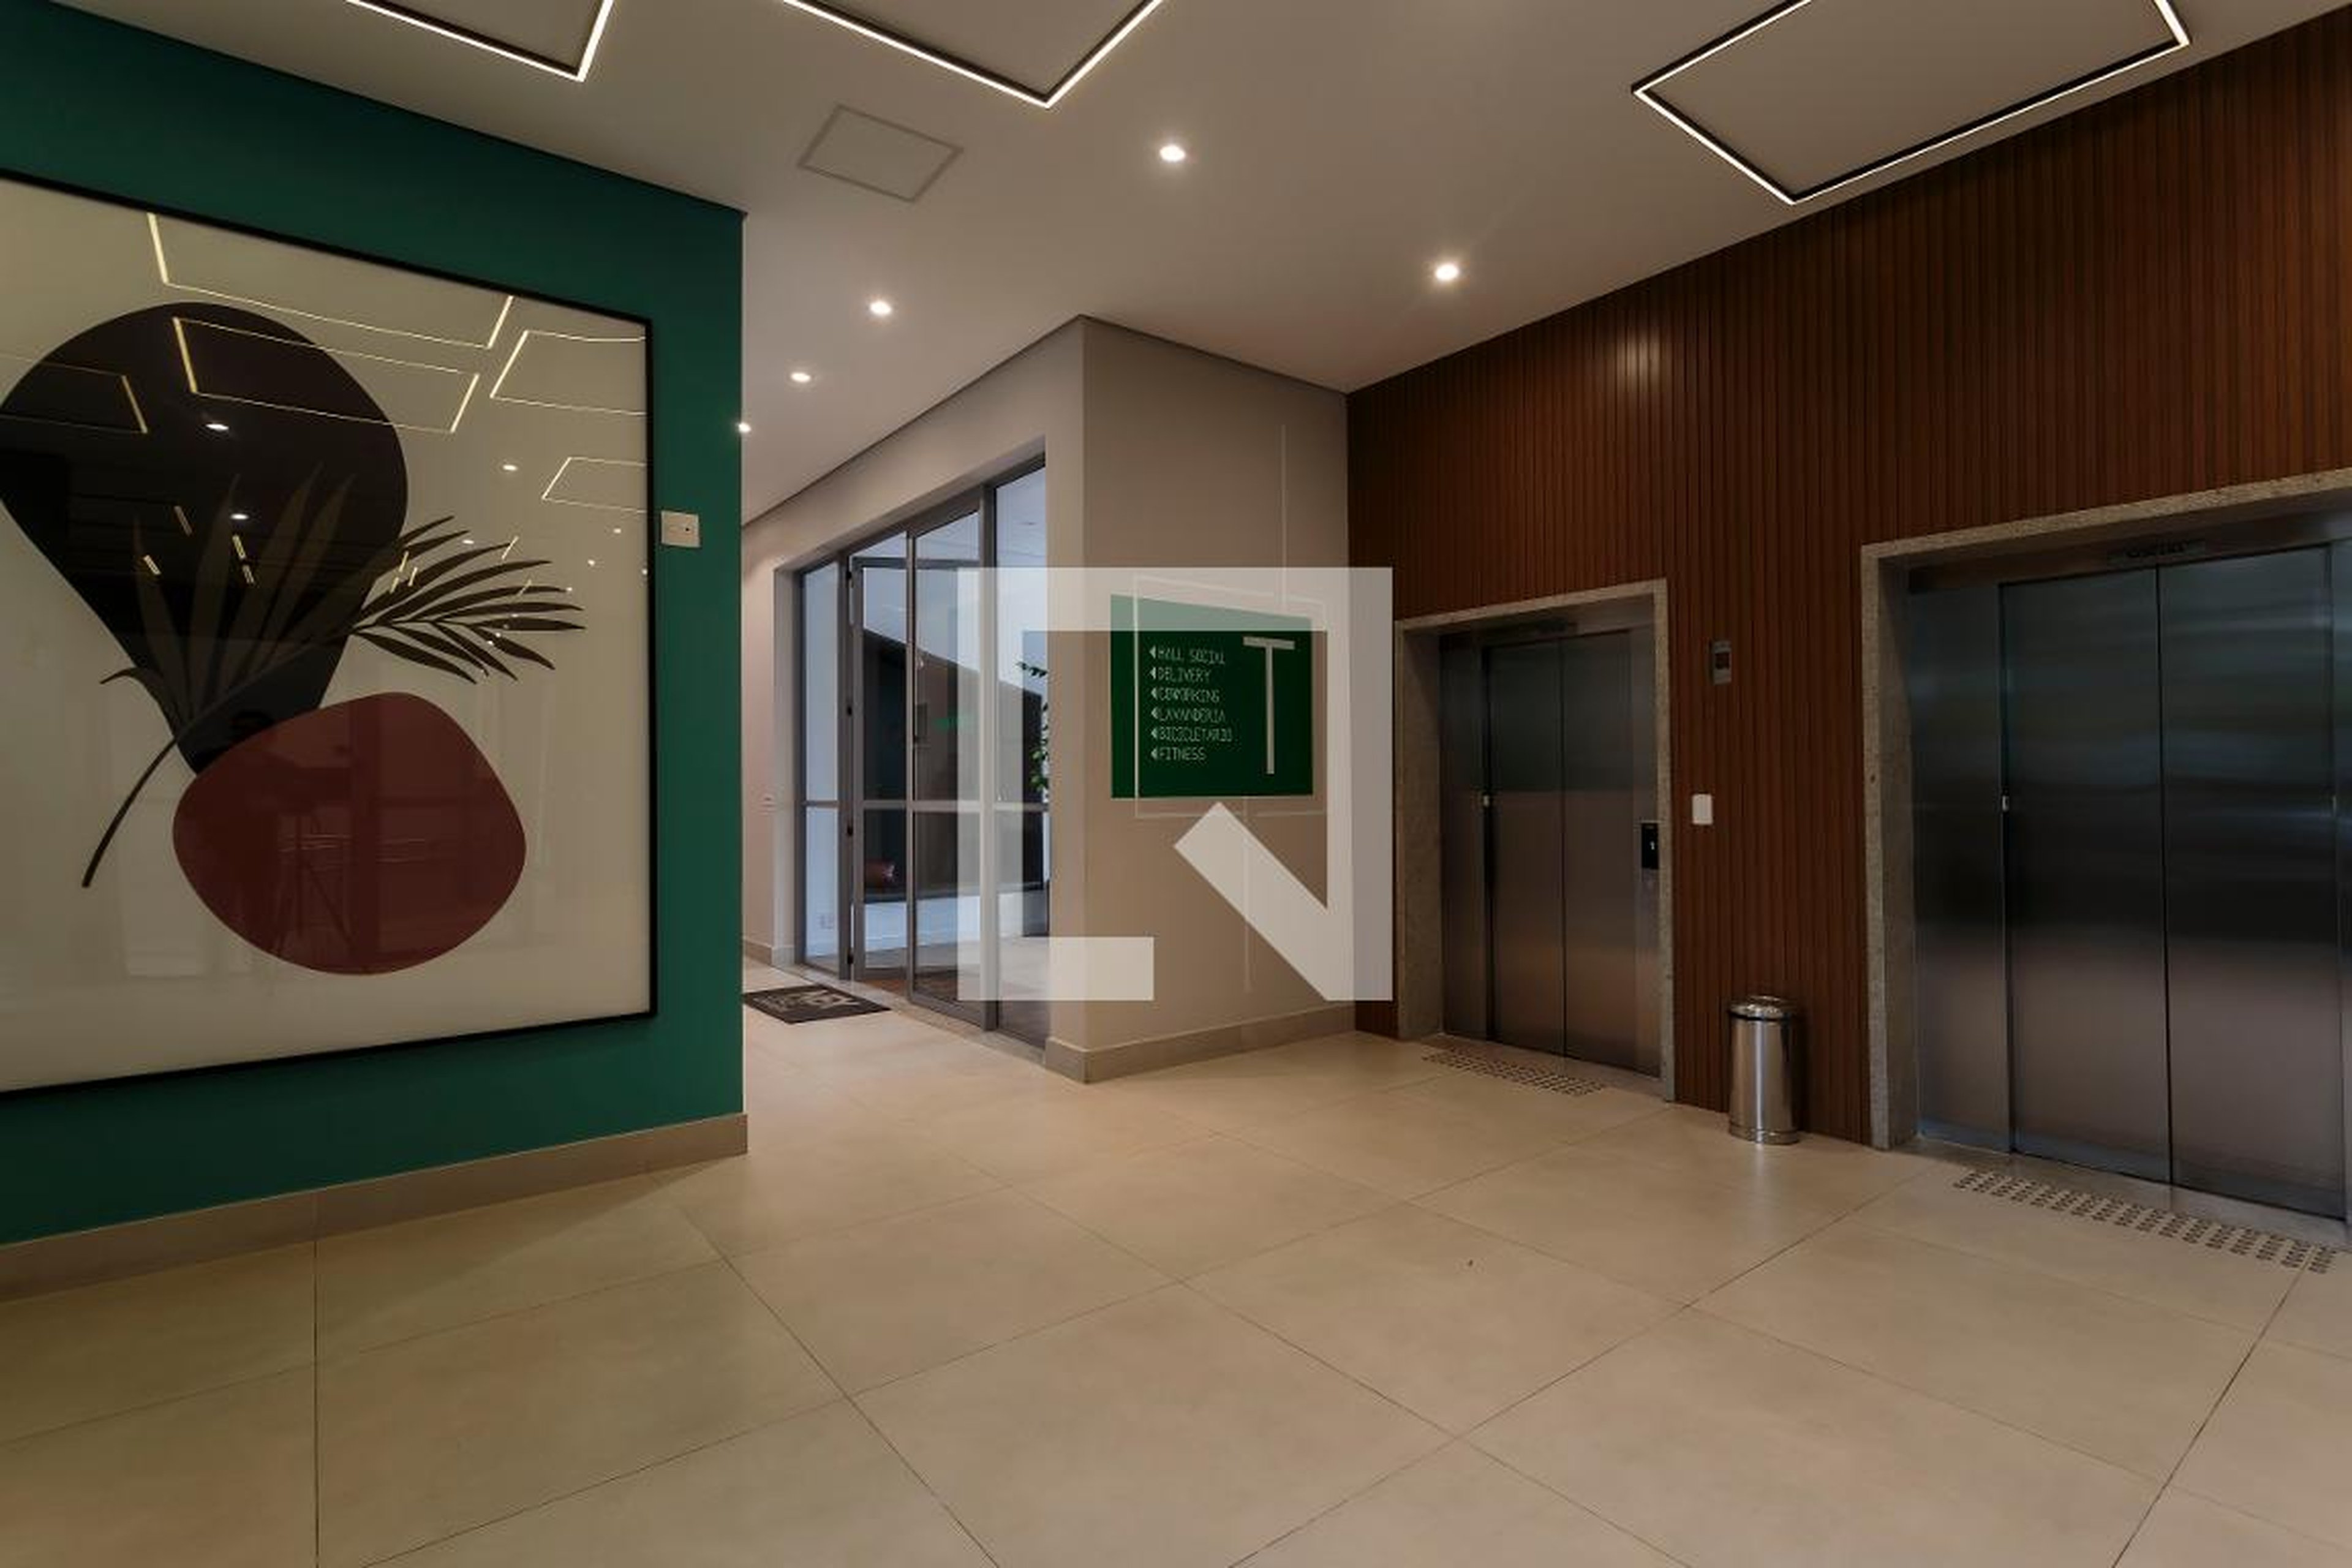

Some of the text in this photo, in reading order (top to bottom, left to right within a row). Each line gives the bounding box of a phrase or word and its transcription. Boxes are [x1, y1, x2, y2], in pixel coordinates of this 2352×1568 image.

[1158, 646, 1225, 665] HALL SOCIAL
[1158, 666, 1212, 683] DELIVERY
[1159, 687, 1220, 703] COWORKING
[1159, 707, 1226, 723] LAVANDERIA
[1159, 747, 1207, 761] FITNESS
